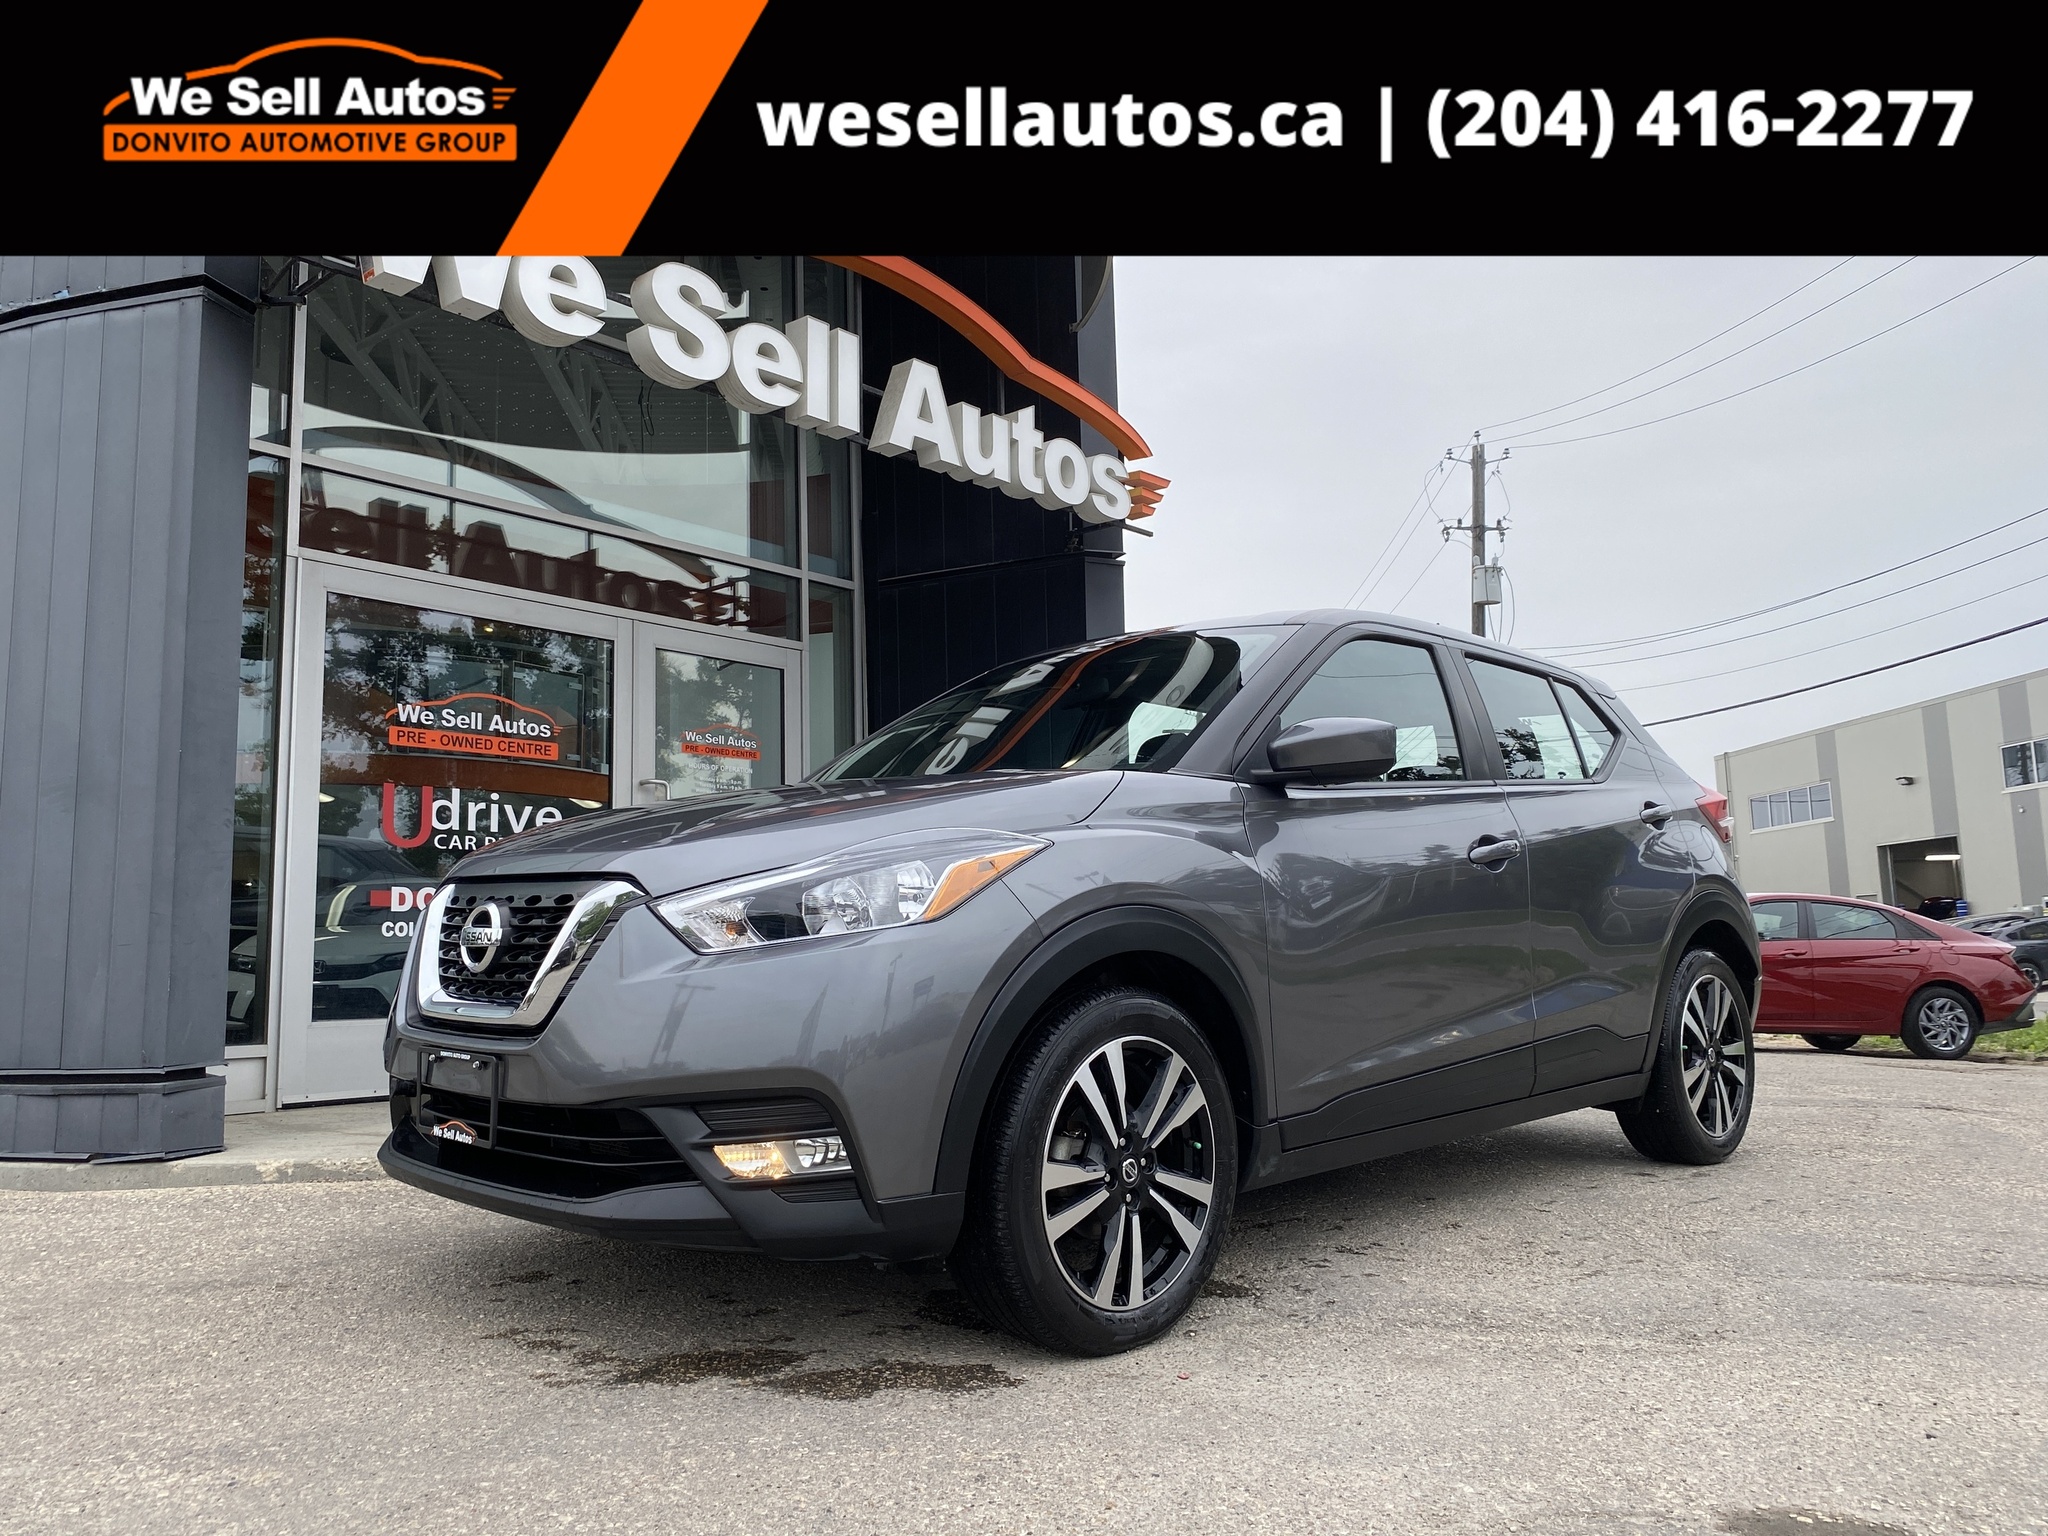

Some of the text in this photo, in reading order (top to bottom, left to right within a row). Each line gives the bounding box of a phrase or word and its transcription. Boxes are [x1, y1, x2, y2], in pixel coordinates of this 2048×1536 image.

[629, 262, 860, 438] Sell
[870, 358, 1132, 523] Autos
[397, 703, 551, 738] We Sell Autos
[396, 730, 427, 744] PRE
[440, 734, 493, 751] OWNED
[497, 740, 552, 756] CENTRE
[685, 731, 757, 749] We Sell Autos
[685, 744, 699, 753] PRE
[704, 747, 730, 756] OWNED
[731, 749, 758, 759] CENTRE
[381, 782, 563, 849] Udrive
[434, 834, 477, 850] CAR
[433, 1125, 473, 1145] We Sell Autos
